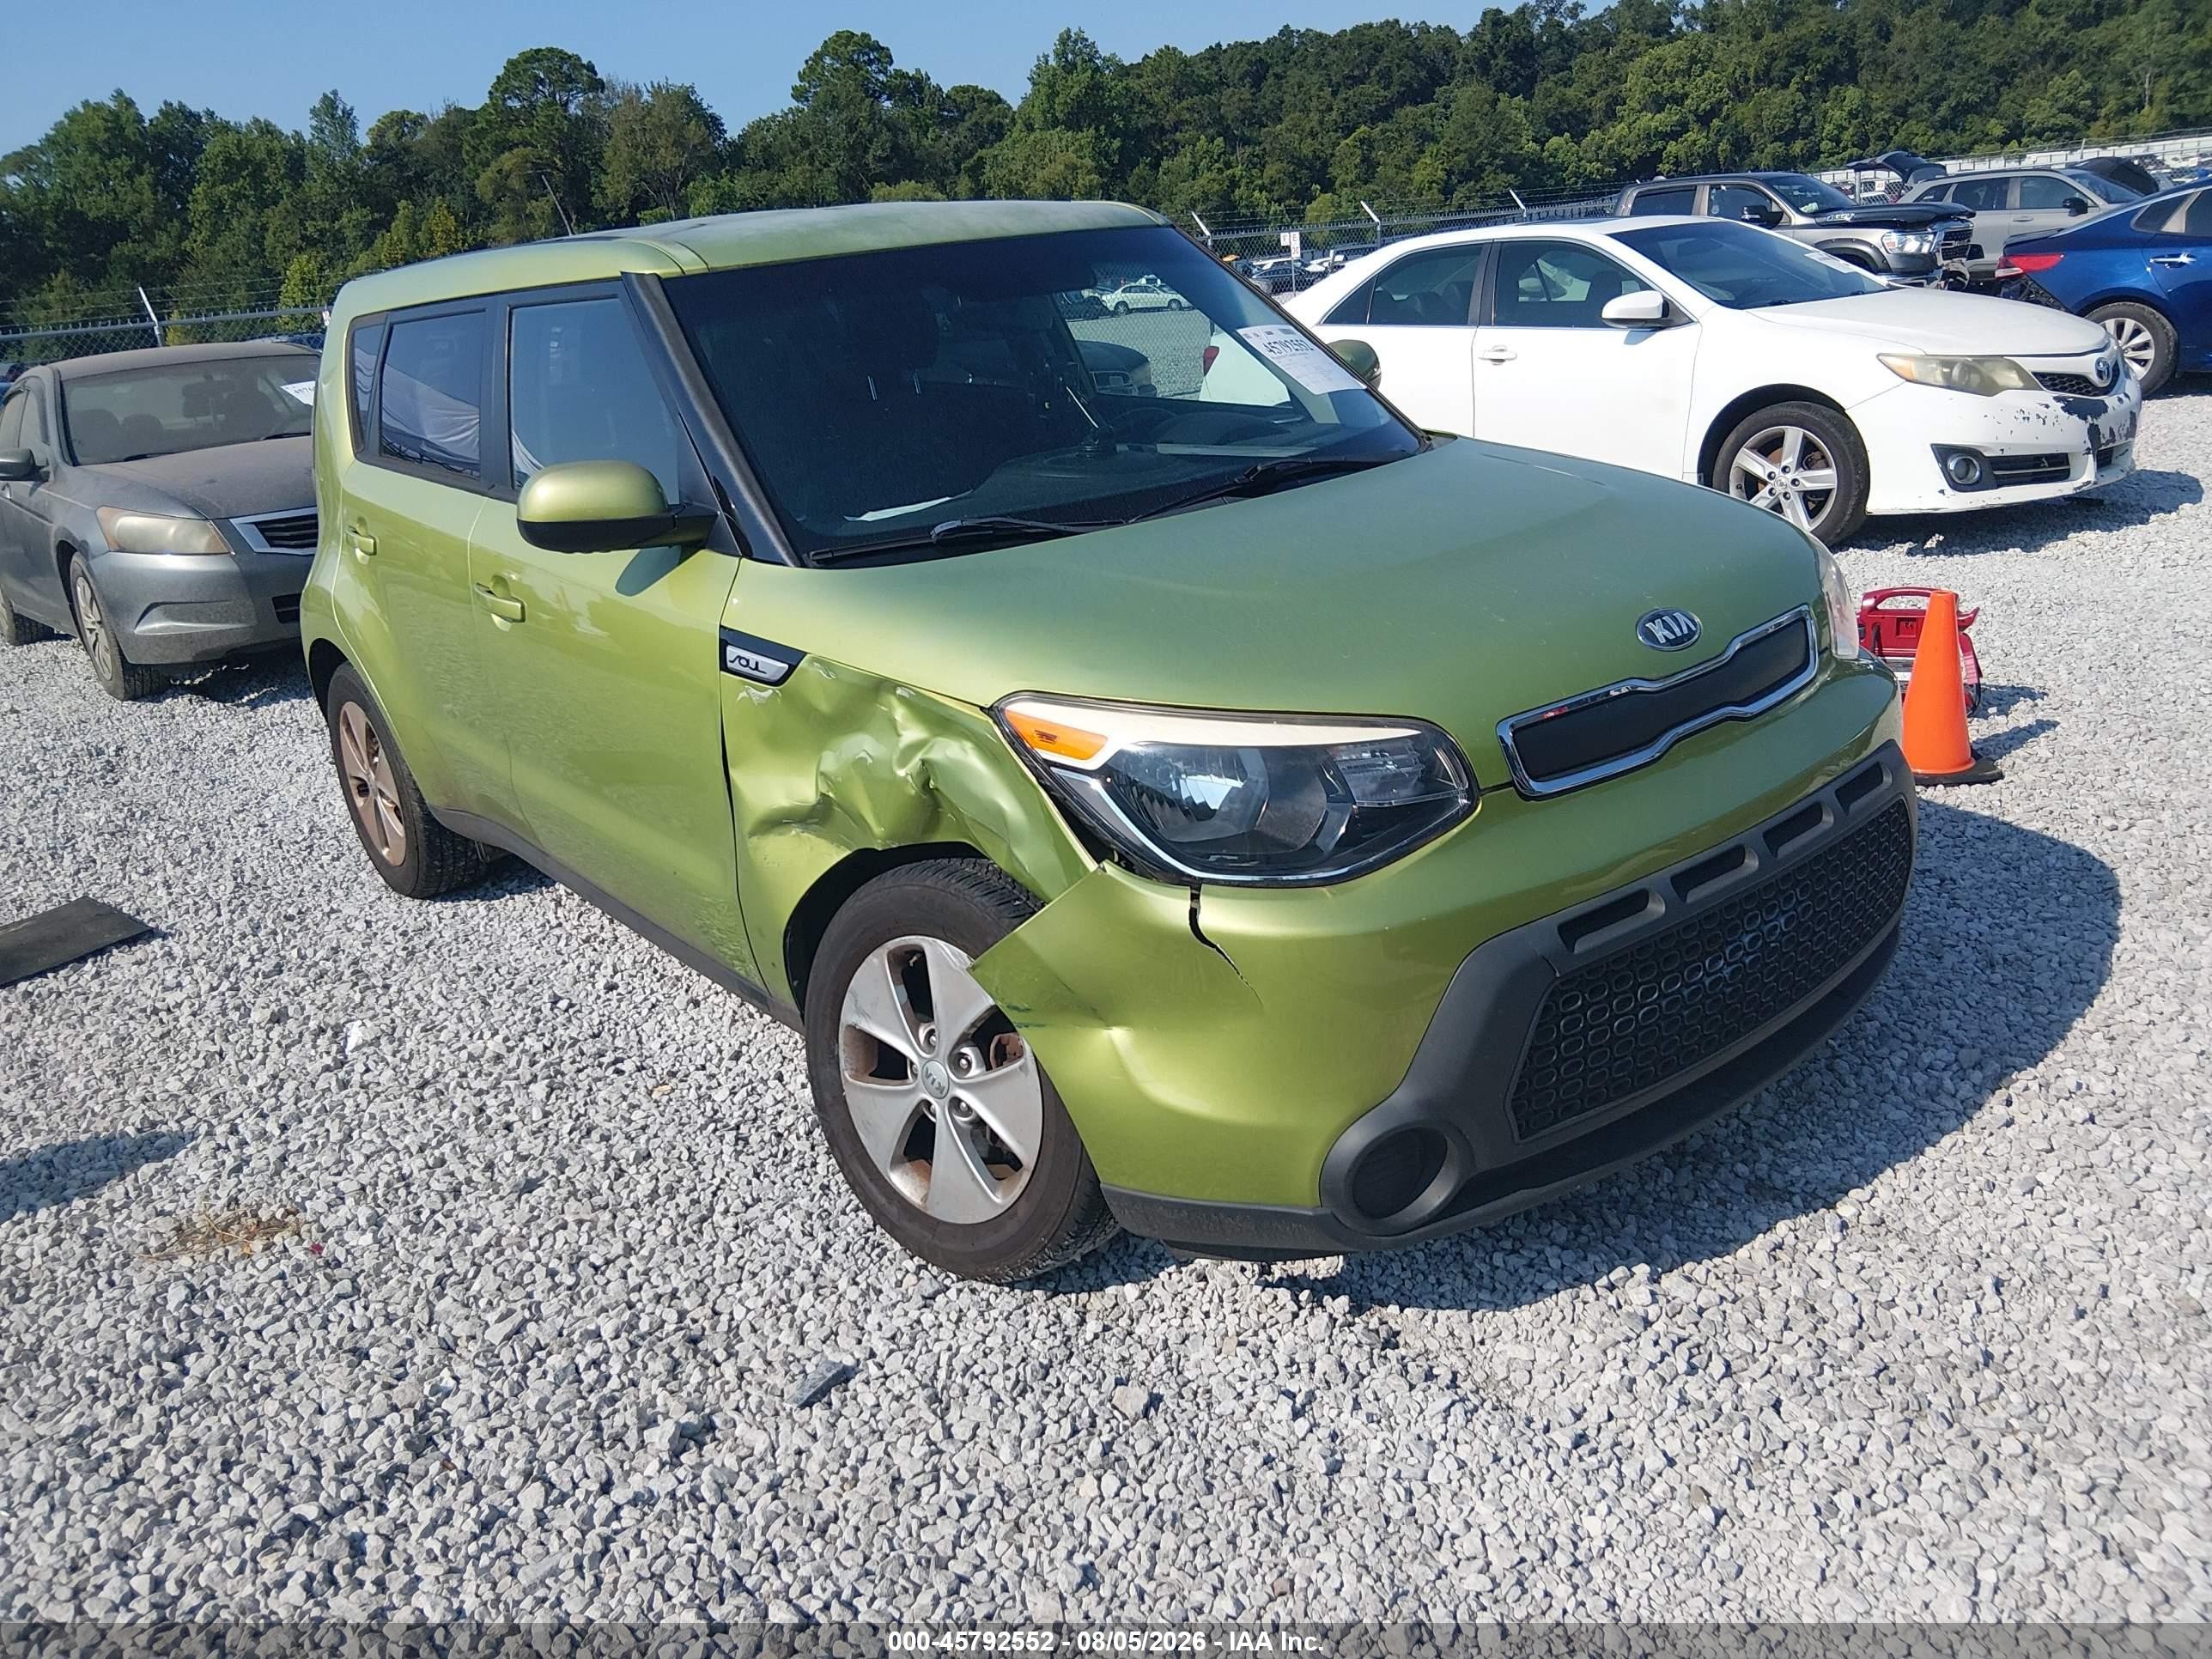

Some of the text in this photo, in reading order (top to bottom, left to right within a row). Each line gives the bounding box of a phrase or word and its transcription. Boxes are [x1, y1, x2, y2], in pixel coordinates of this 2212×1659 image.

[1262, 339, 1315, 355] 45792552
[1645, 612, 1696, 644] KIA
[925, 1066, 945, 1095] KIA
